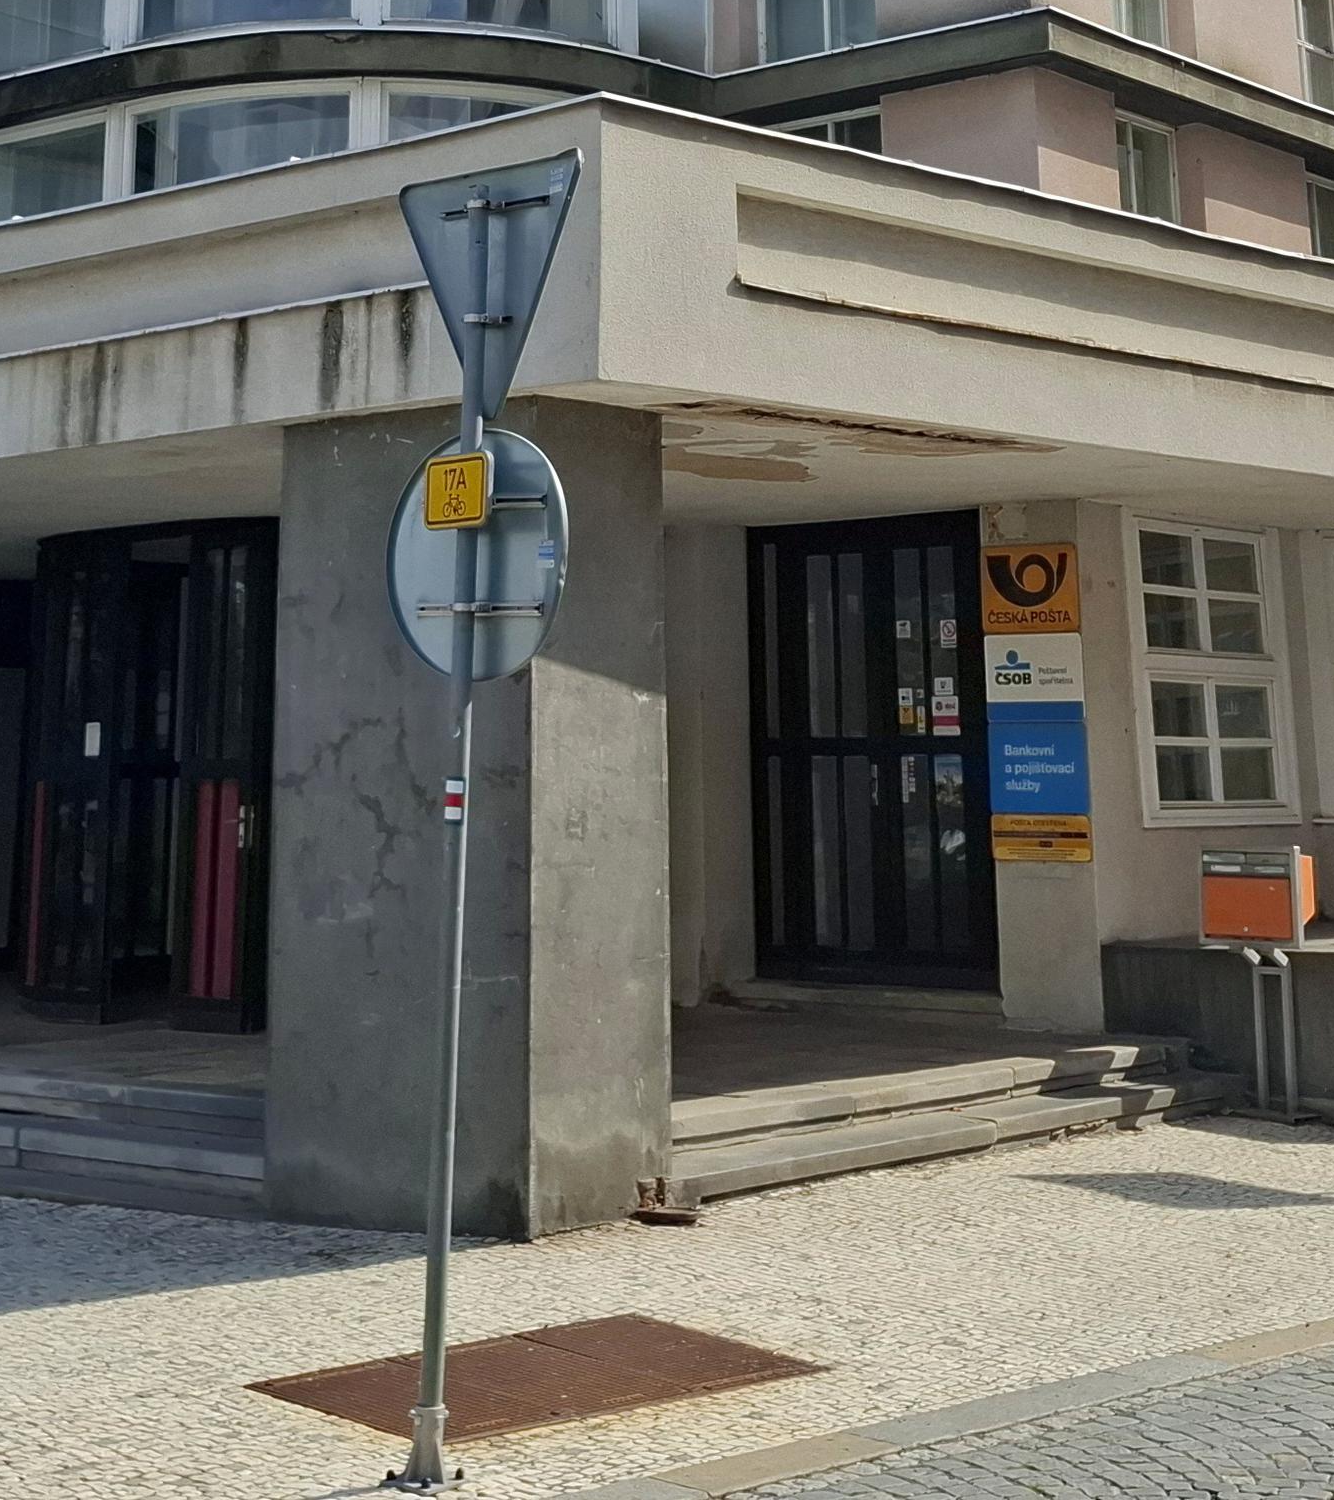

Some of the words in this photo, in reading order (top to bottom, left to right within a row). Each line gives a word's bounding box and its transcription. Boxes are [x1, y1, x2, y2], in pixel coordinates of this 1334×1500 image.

[443, 467, 467, 492] 17A
[988, 609, 1028, 625] ČESKÁ
[1030, 608, 1072, 624] POŠTA
[995, 672, 1032, 686] ČSOB
[1004, 744, 1055, 756] Bankovní
[1005, 764, 1012, 773] a
[1014, 761, 1075, 776] pojišťovací
[1005, 779, 1041, 794] služby
